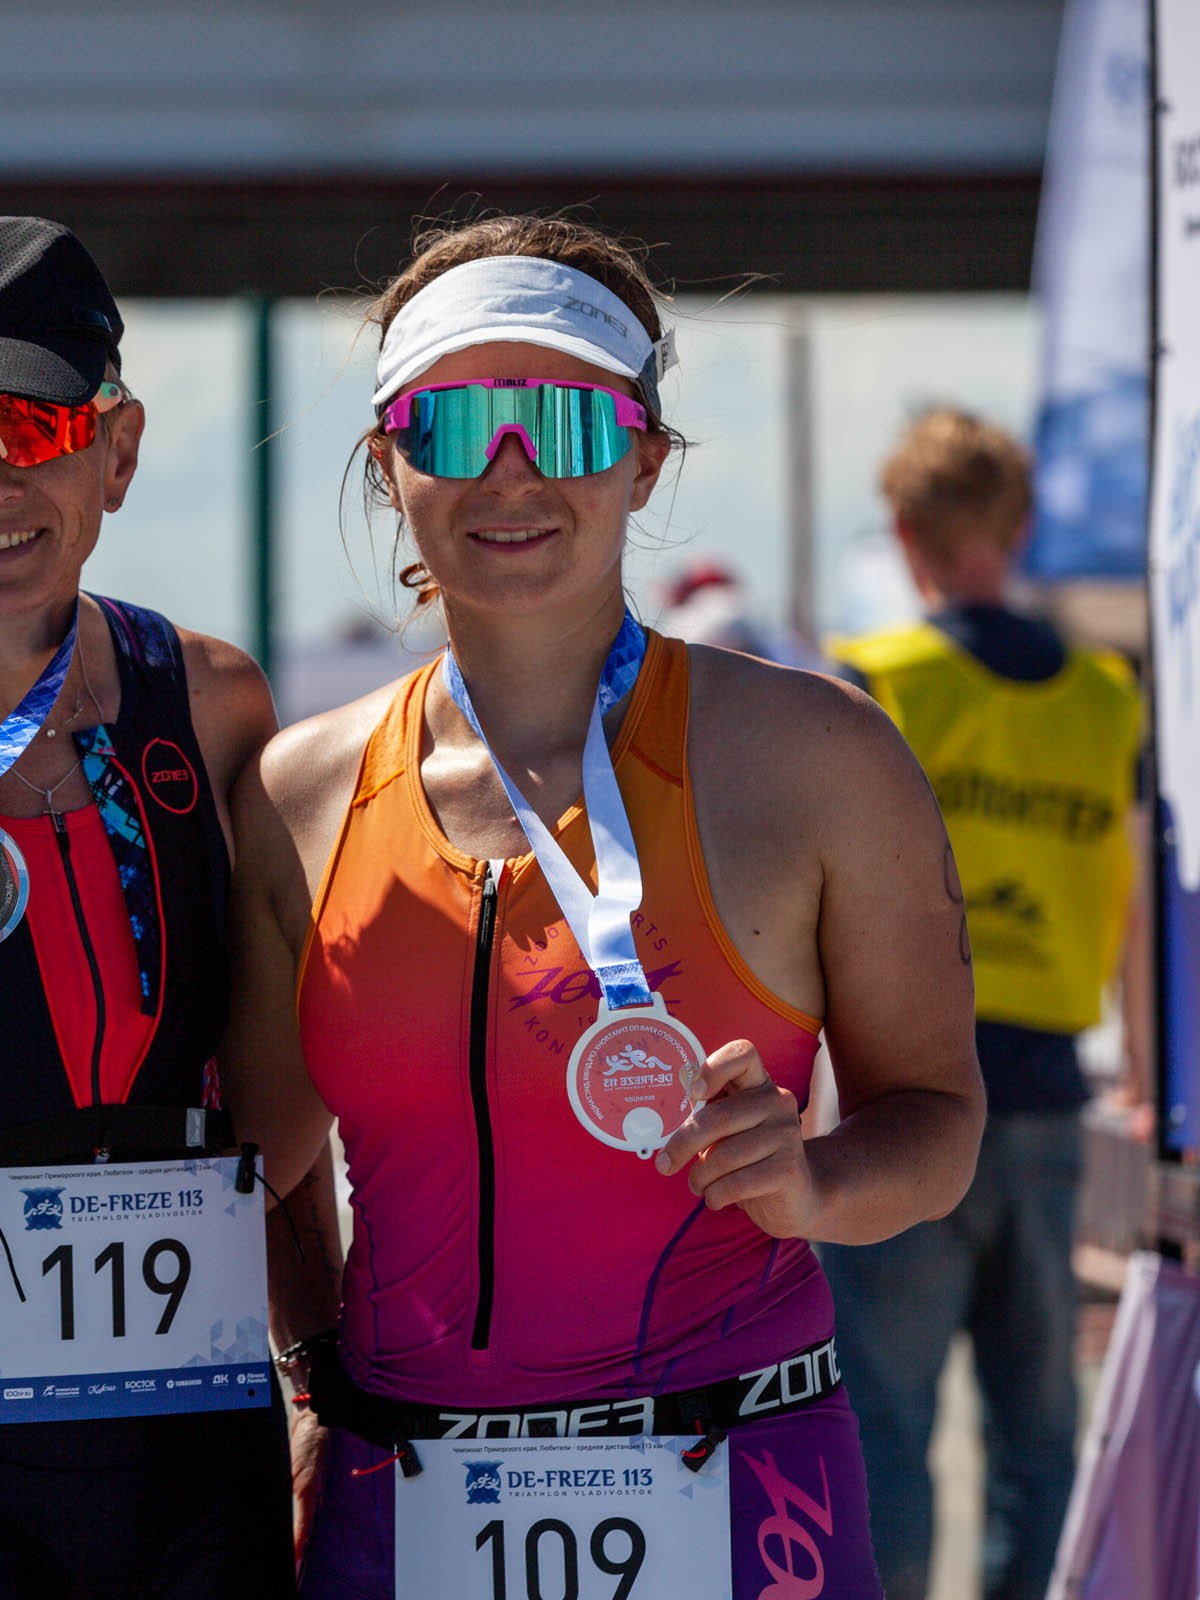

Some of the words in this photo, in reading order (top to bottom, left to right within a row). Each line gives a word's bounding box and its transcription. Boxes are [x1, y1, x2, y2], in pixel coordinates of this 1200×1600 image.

[69, 1192, 173, 1214] DE-FREZE
[178, 1189, 204, 1208] 113
[136, 1210, 204, 1219] VLADIVOSTOK
[41, 1238, 192, 1341] 119
[507, 1469, 616, 1489] DE-FREZE
[622, 1468, 654, 1487] 113
[575, 1489, 654, 1497] VLADIVOSTOK
[474, 1517, 648, 1600] 109
